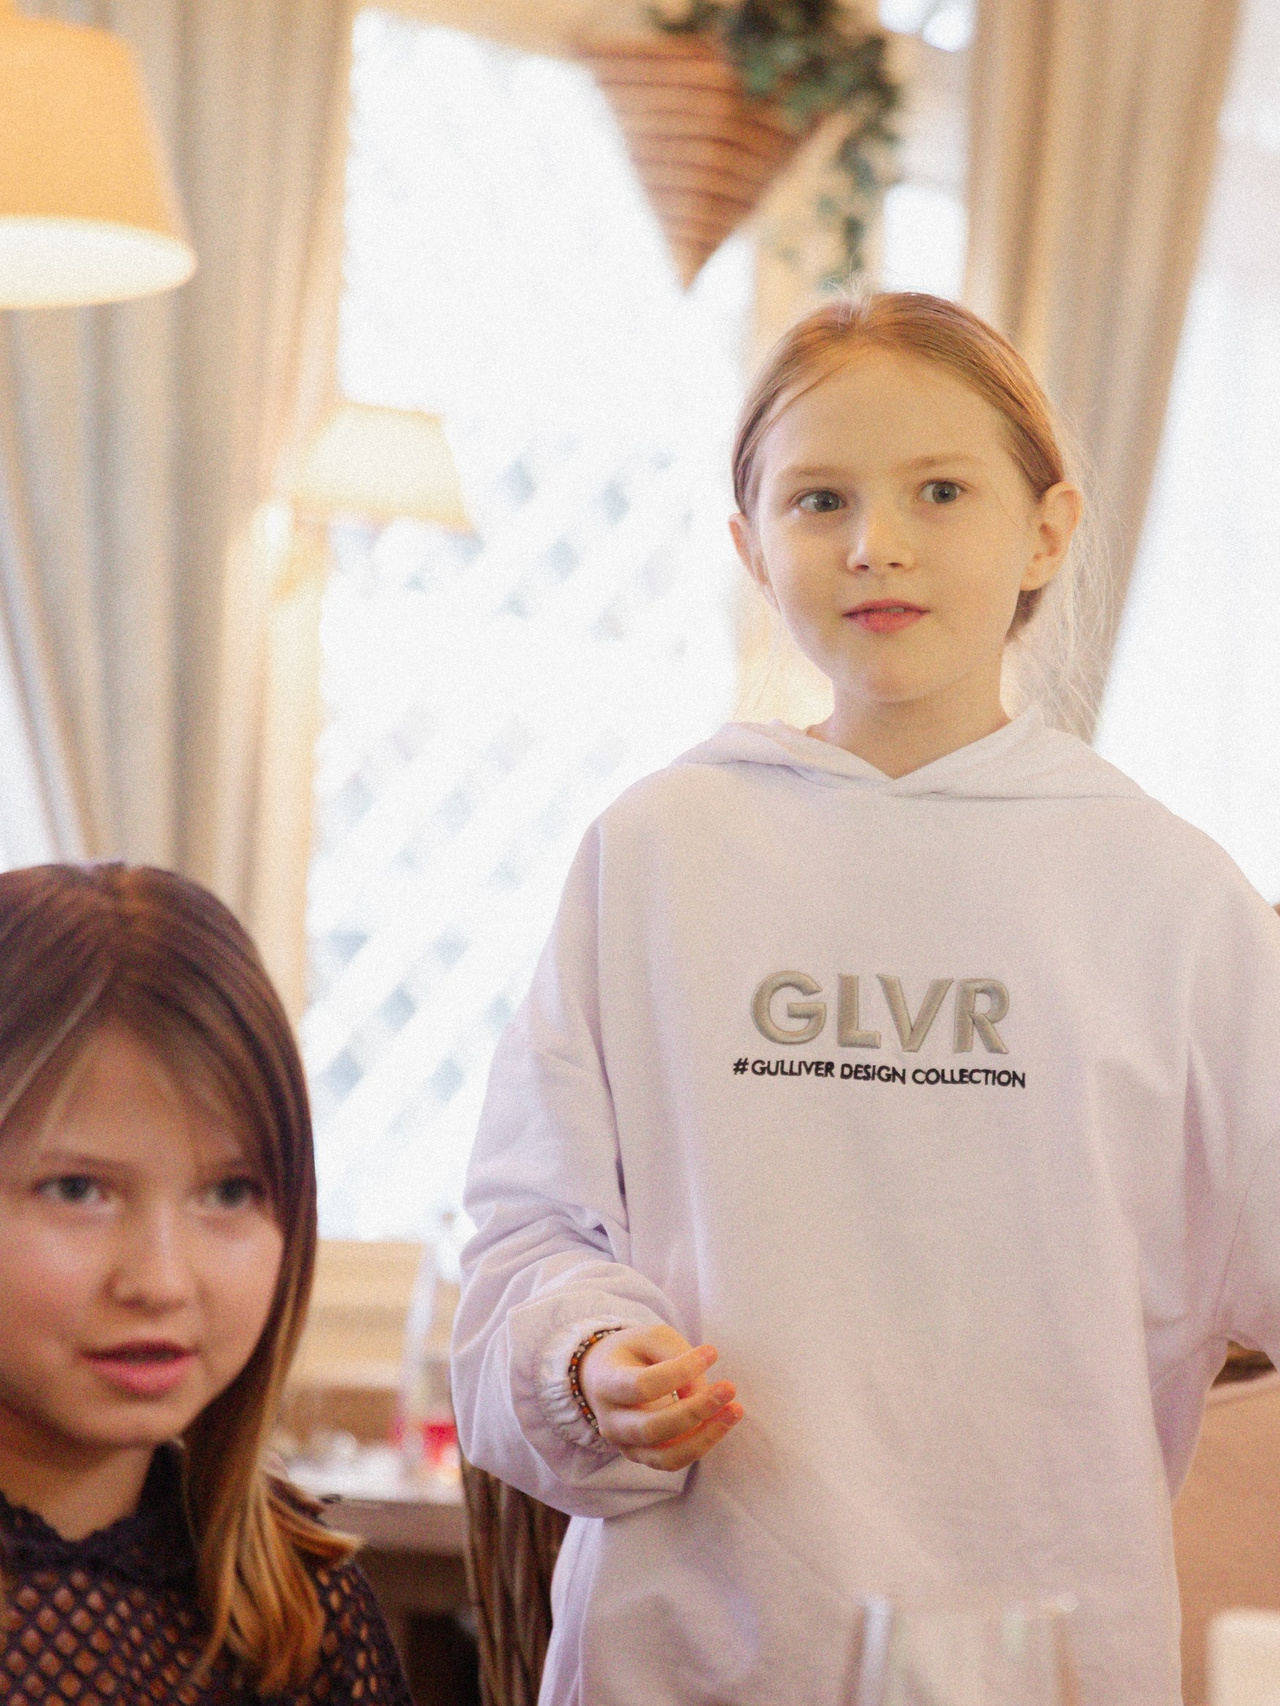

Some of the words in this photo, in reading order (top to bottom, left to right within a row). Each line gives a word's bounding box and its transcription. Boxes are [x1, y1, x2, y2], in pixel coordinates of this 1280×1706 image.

[752, 970, 1010, 1054] GLVR
[733, 1058, 835, 1078] #GULLIVER
[840, 1063, 906, 1084] DESIGN
[911, 1068, 1026, 1088] COLLECTION
